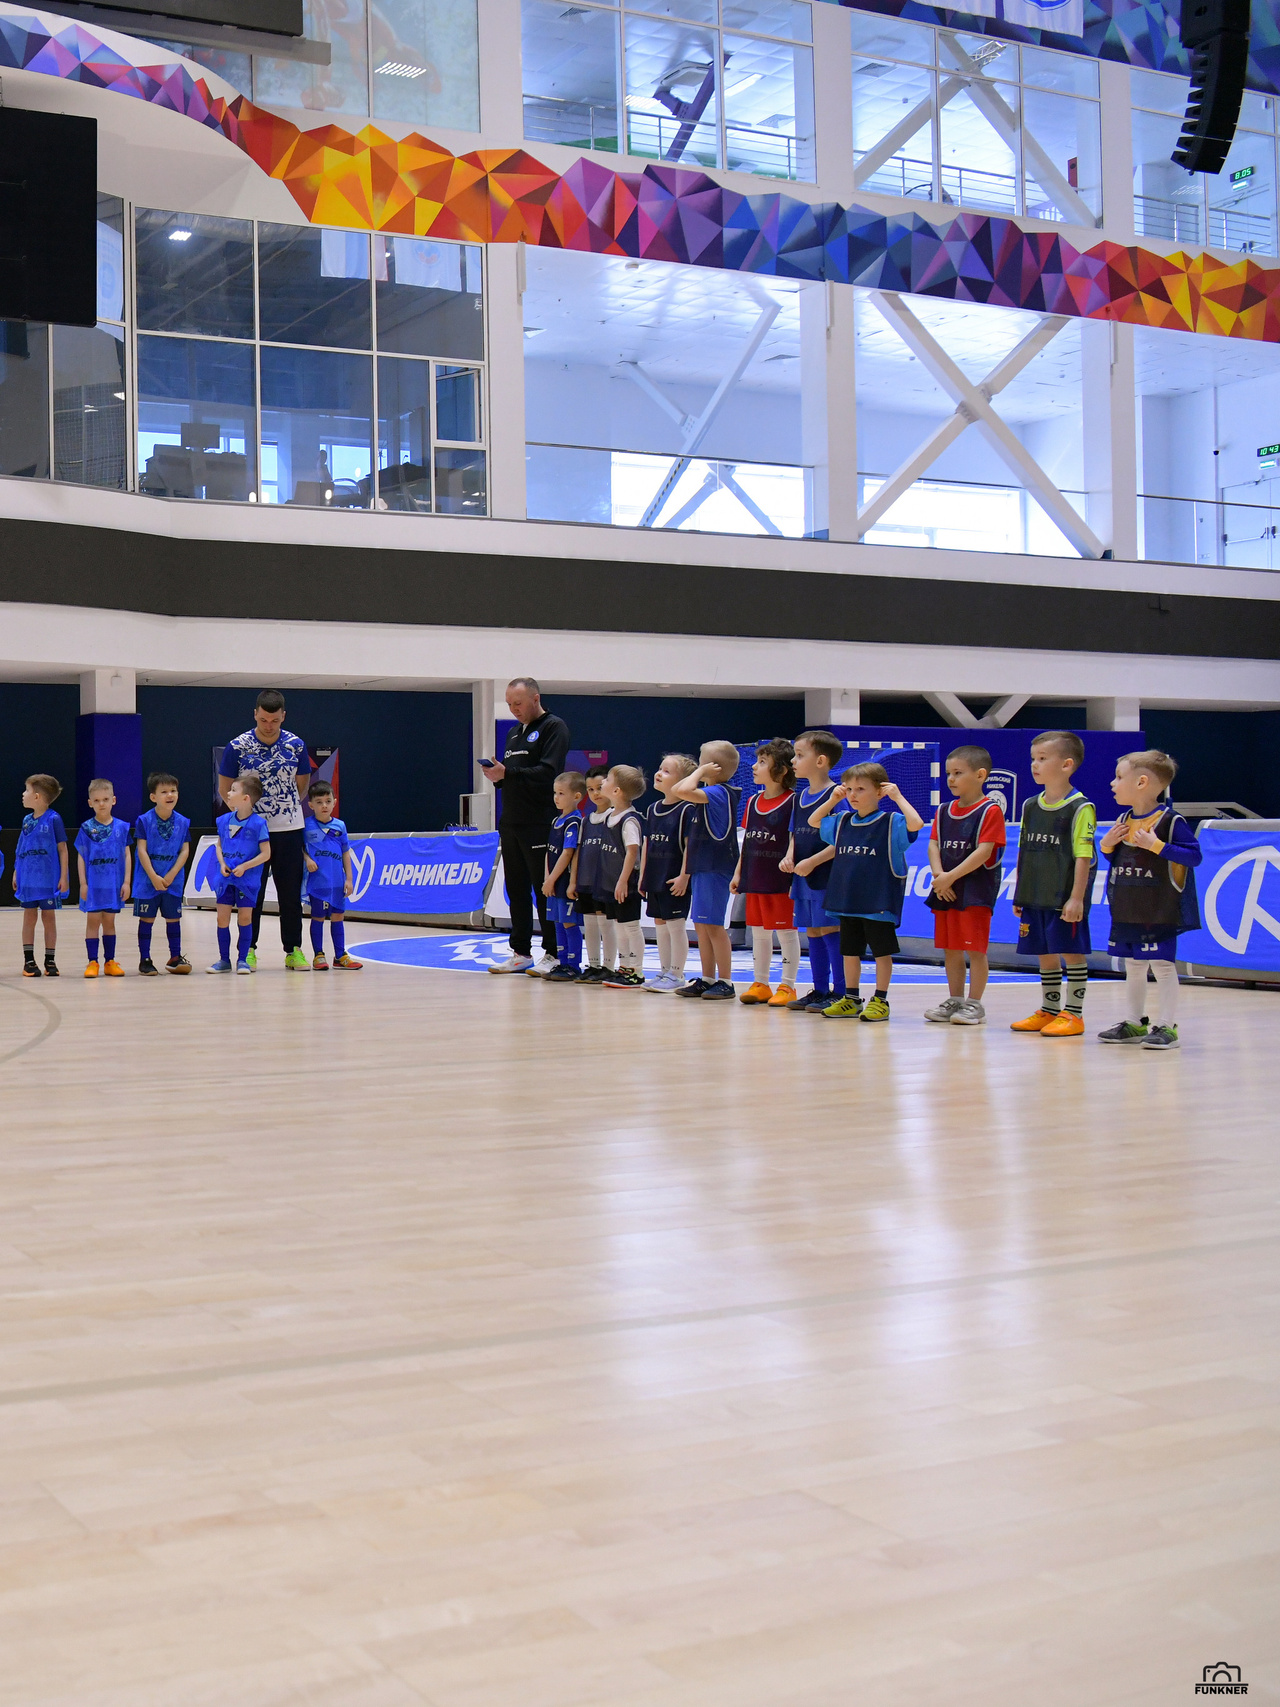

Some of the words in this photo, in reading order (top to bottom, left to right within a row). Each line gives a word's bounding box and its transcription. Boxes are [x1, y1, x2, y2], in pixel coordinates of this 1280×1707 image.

[650, 833, 669, 842] PSTA
[379, 861, 483, 886] НОРНИКЕЛЬ
[566, 902, 574, 916] 7
